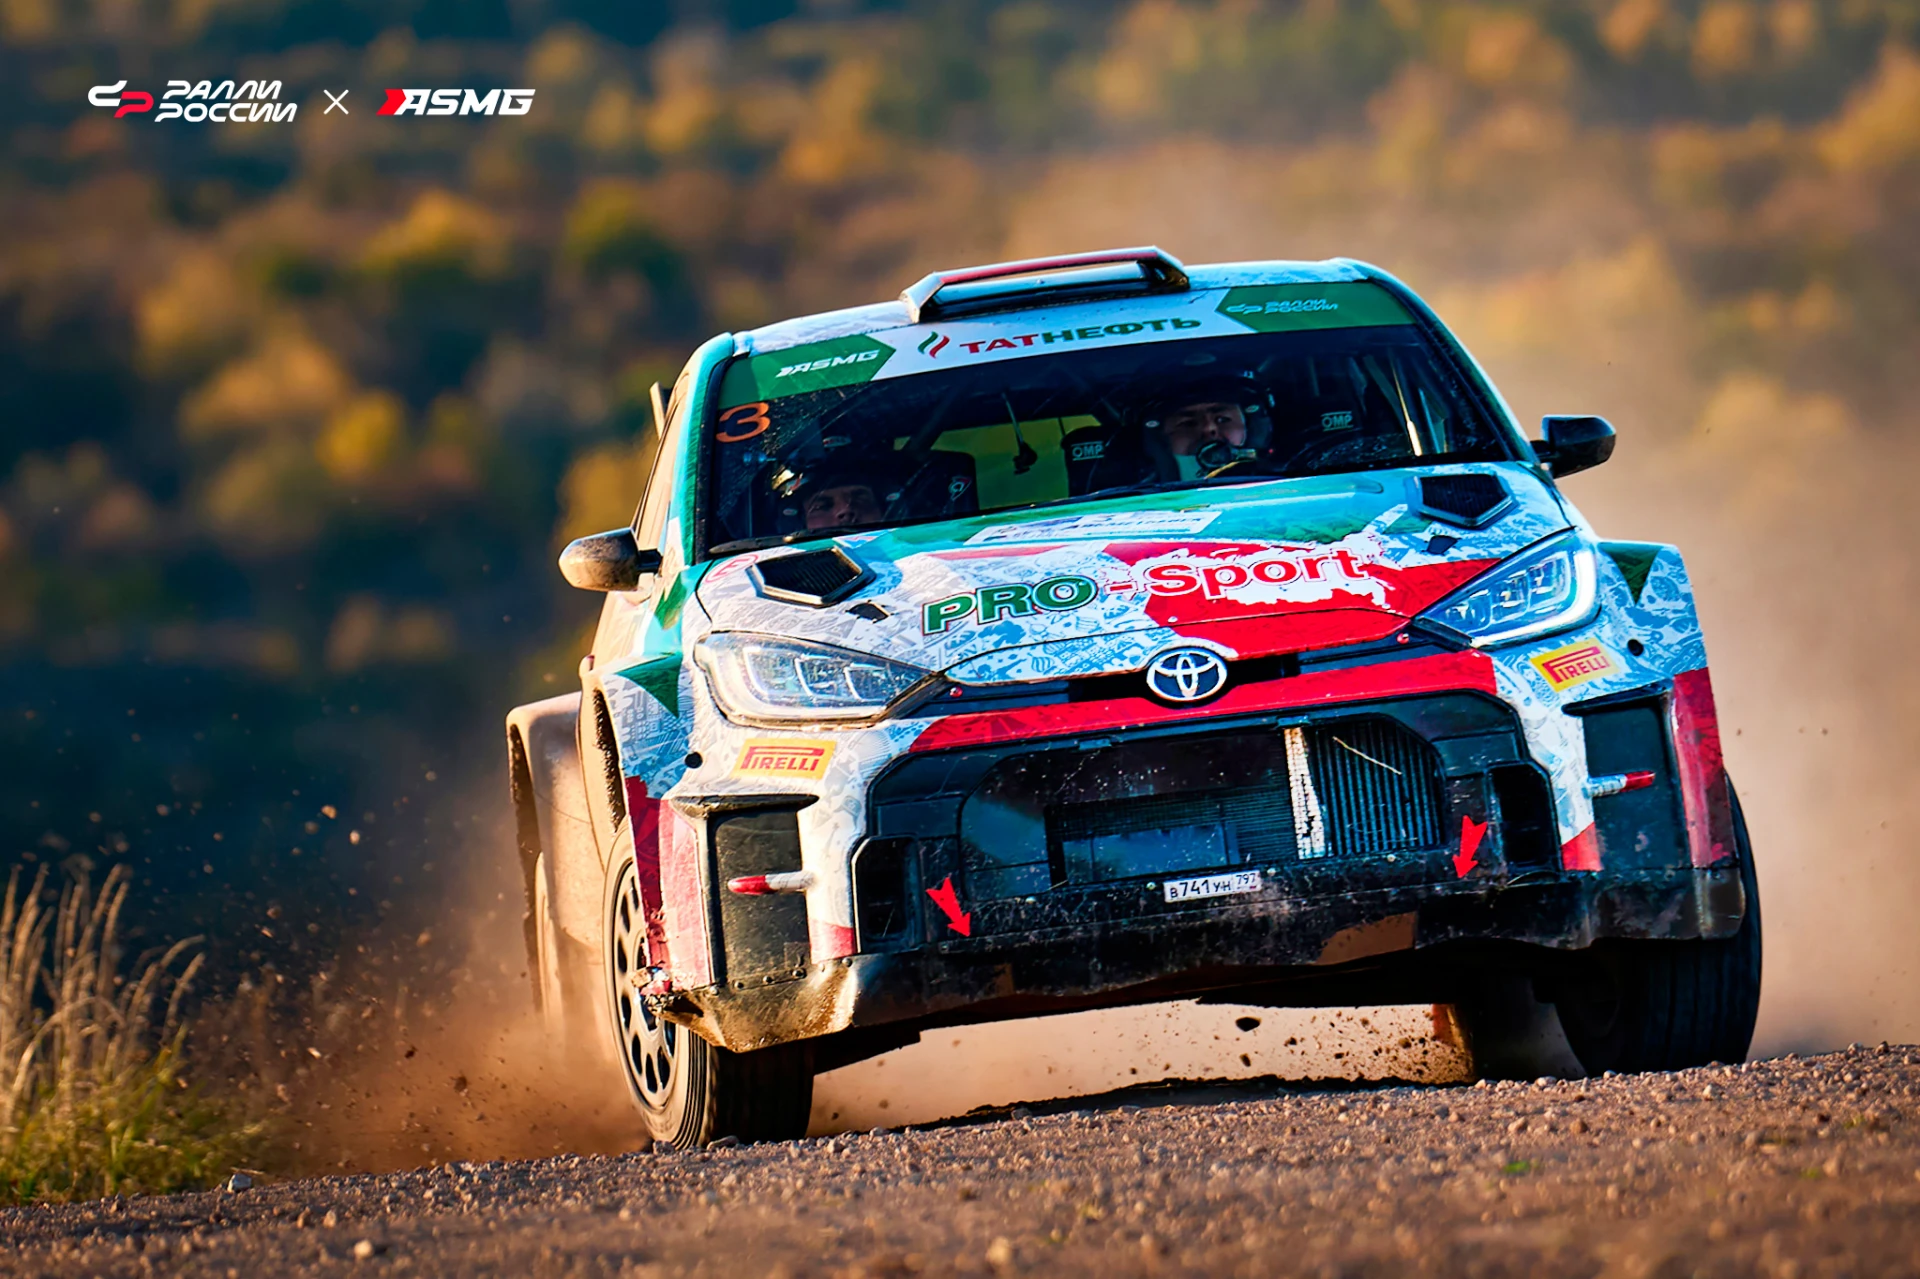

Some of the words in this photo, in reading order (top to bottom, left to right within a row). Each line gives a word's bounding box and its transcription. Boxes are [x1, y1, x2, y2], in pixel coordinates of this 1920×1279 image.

[959, 317, 1201, 354] ТАТНЕФТЬ
[785, 349, 881, 376] ASMG
[716, 402, 771, 443] 3
[1322, 414, 1352, 428] OMP
[1072, 444, 1103, 458] OMP
[1541, 646, 1611, 684] PIRELLI
[740, 746, 825, 771] PIRELLI
[1235, 872, 1257, 885] 797
